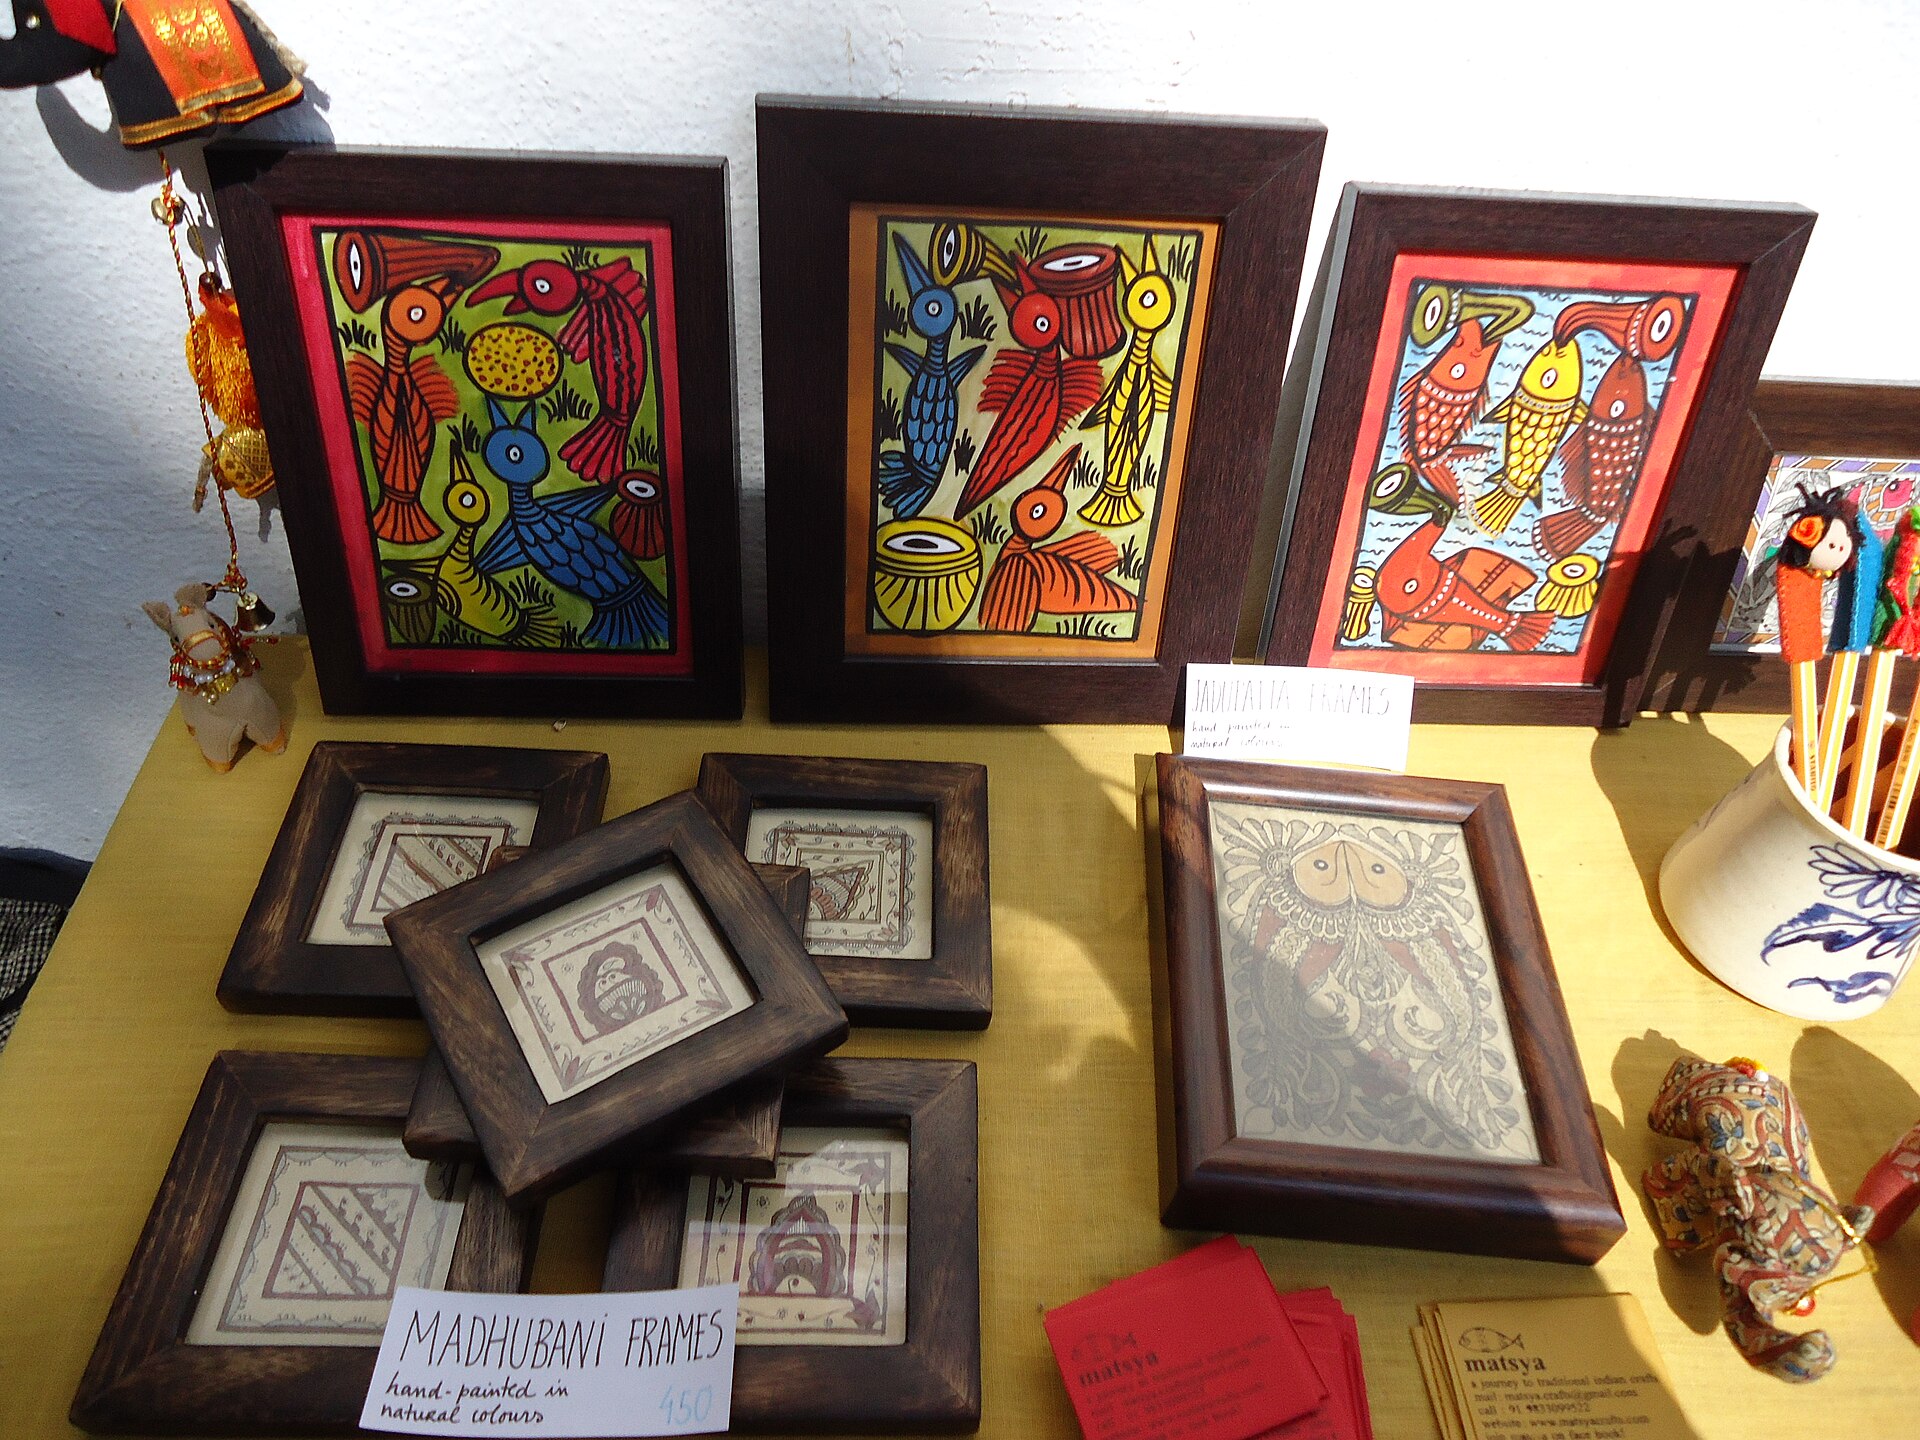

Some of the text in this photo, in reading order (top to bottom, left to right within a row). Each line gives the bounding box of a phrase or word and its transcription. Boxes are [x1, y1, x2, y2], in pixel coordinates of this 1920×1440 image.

[624, 1309, 724, 1369] FRAMES
[1463, 1355, 1547, 1377] matsya
[544, 1376, 569, 1399] in
[1523, 1379, 1534, 1387] to
[380, 1402, 545, 1425] natural colours
[658, 1385, 713, 1426] 450
